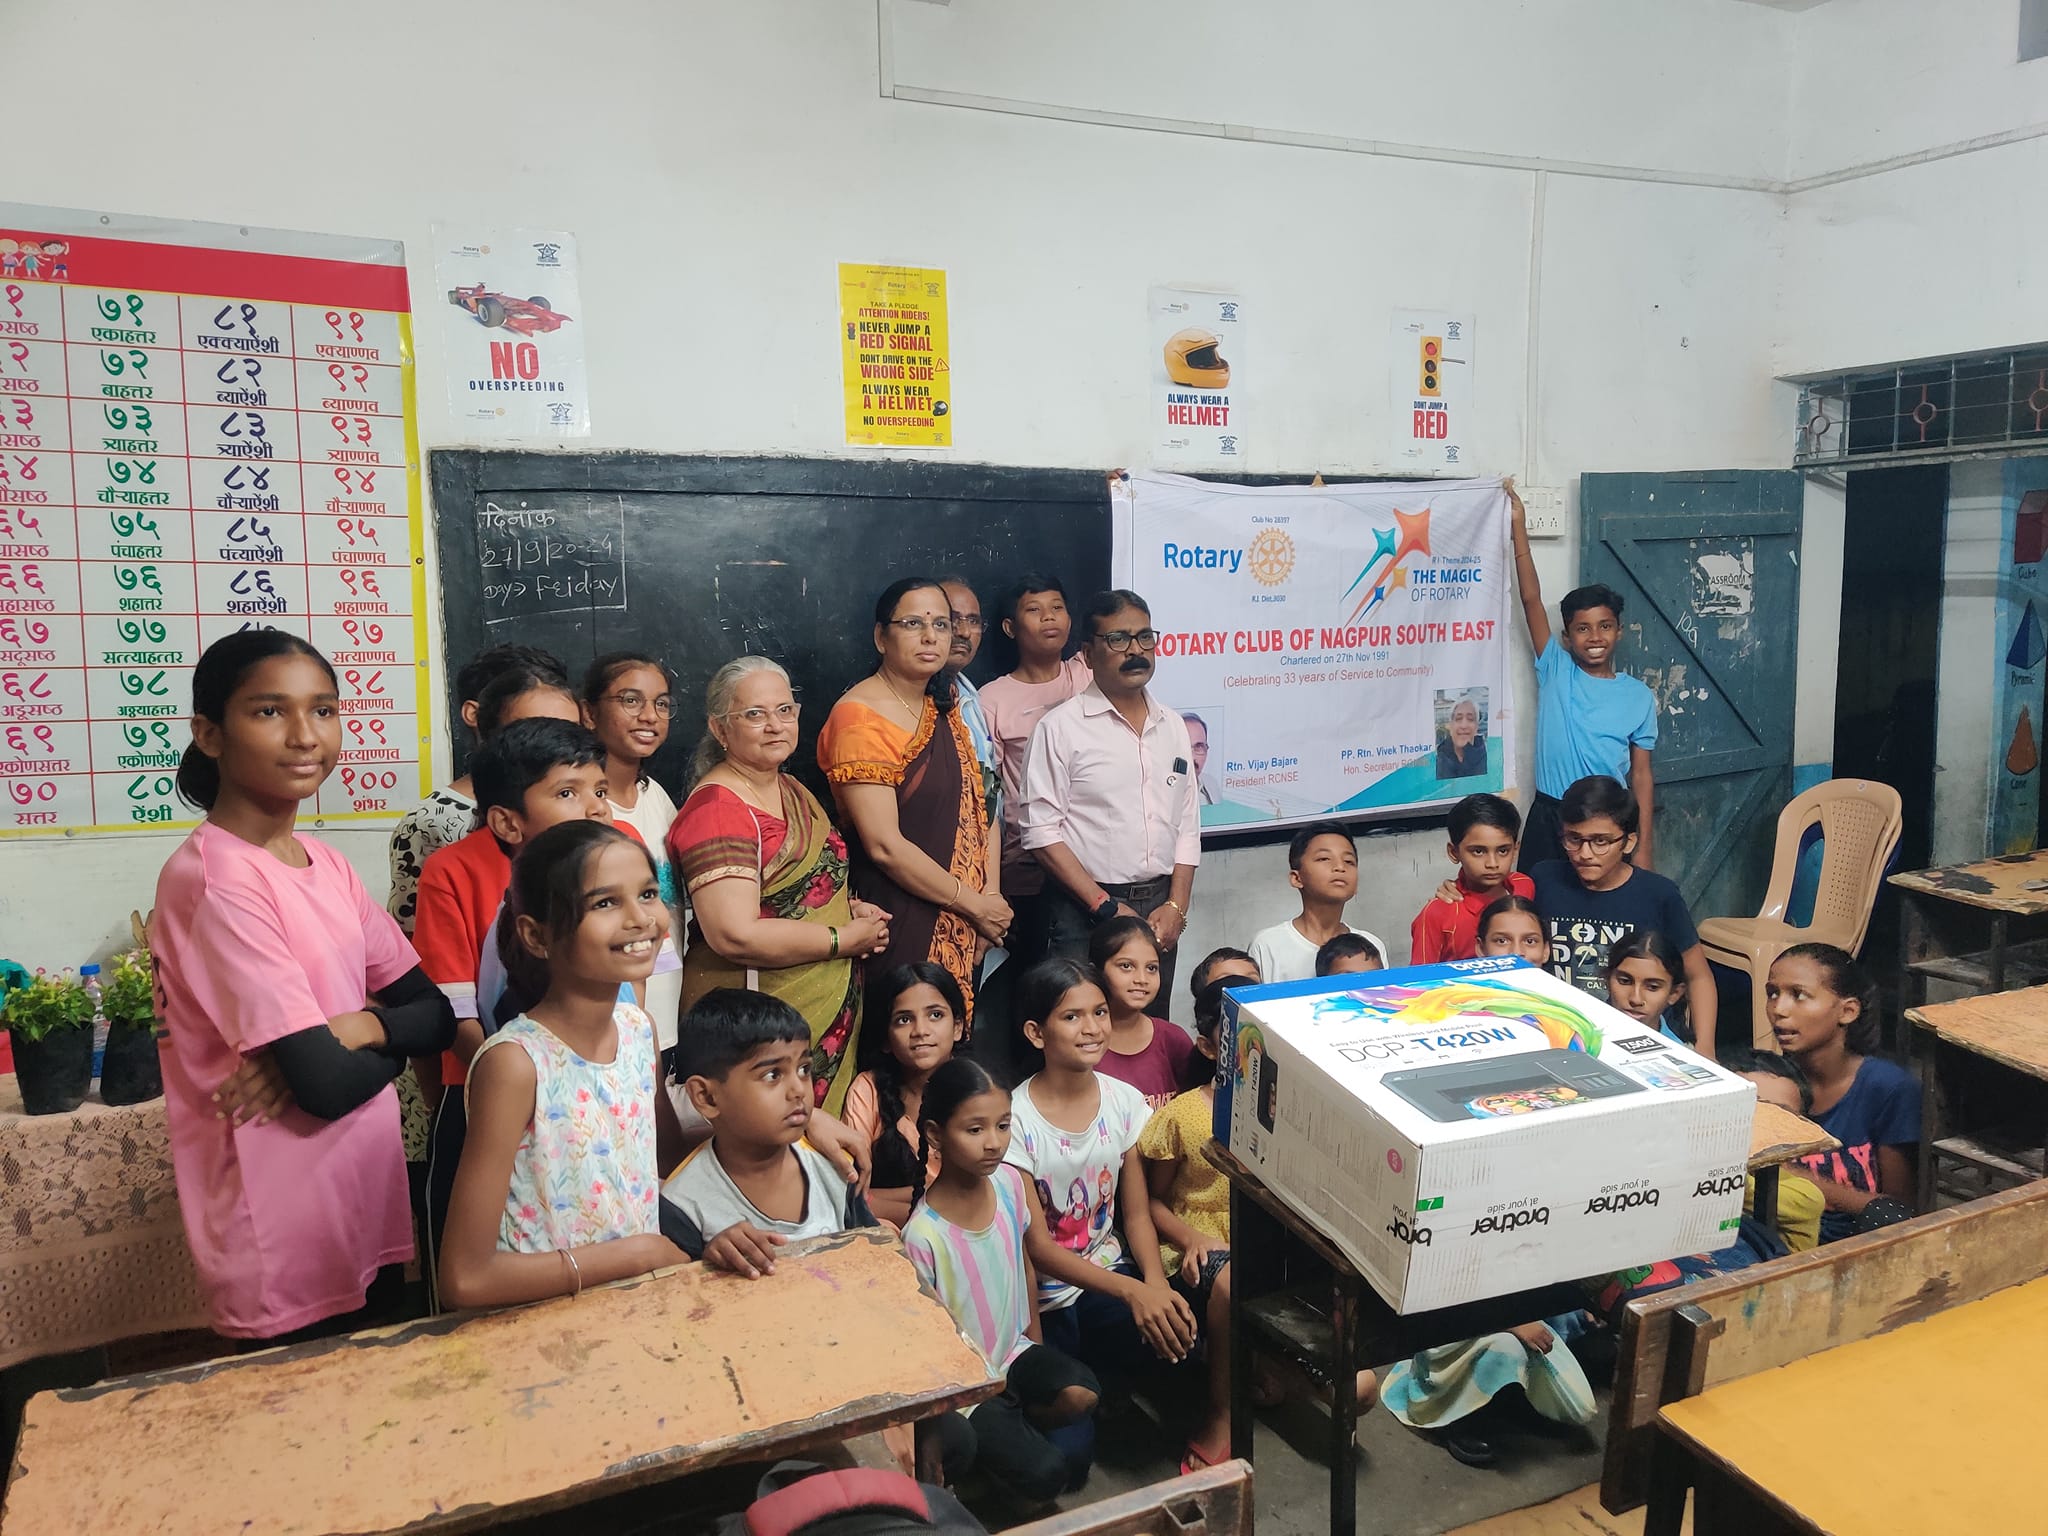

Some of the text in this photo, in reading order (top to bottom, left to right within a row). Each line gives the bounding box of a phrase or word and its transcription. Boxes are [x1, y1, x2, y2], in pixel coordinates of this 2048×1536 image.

[97, 294, 144, 327] ७१
[213, 303, 257, 335] ८१
[859, 308, 931, 321] ATTENTION RIDERS!
[91, 327, 157, 344] एकाहत्तर
[325, 311, 365, 343] ९१
[859, 322, 931, 336] NEVER JUMP A
[859, 333, 934, 352] RED SIGNAL
[101, 349, 149, 380] ७२
[217, 358, 262, 387] ८२
[490, 341, 540, 381] NO
[860, 364, 935, 381] WRONG SIDE
[882, 354, 905, 366] DRIVE
[906, 355, 917, 366] ON
[919, 355, 933, 366] THE
[328, 363, 369, 393] ९२
[469, 380, 565, 392] OVERSPEEDING
[862, 384, 930, 397] ALWAYS WEAR
[101, 383, 153, 399] बाहत्तर
[863, 395, 933, 411] A HELMET
[1167, 393, 1230, 406] ALWAYS WEAR A
[321, 397, 380, 413] ब्याण्णव
[1167, 405, 1230, 427] HELMET
[1428, 402, 1443, 410] JUMP
[1443, 402, 1448, 411] A
[104, 403, 153, 436] ७३
[220, 411, 266, 443] ८३
[331, 416, 372, 447] ९३
[863, 415, 935, 428] NO OVERSPEEDING
[1413, 410, 1448, 440] RED
[107, 457, 157, 485] ७४
[224, 464, 270, 491] ८४
[334, 467, 376, 495] ९४
[110, 511, 160, 540] ७५
[478, 501, 557, 529] दिनांक
[227, 516, 274, 545] ८५
[337, 518, 379, 546] ९५
[111, 540, 163, 559] पंचाहत्तर
[1163, 543, 1243, 574] Rotary
[114, 564, 162, 595] ७६
[230, 569, 276, 599] ८६
[340, 568, 381, 598] ९६
[1413, 568, 1482, 584] THE MAGIC
[119, 597, 163, 611] शहात्तर
[226, 596, 287, 614] शहाऐंशी
[1411, 587, 1471, 602] OF ROTARY
[334, 601, 389, 615] शहाण्णव
[0, 618, 49, 648] ६७
[117, 618, 167, 643] ७७
[342, 619, 384, 647] ९७
[1234, 629, 1284, 654] CLUB
[1289, 628, 1314, 651] OF
[1320, 626, 1392, 649] NAGPUR
[1396, 623, 1447, 645] SOUTH
[1452, 620, 1495, 642] EAST
[1280, 651, 1389, 666] Chartered on 27th Nov 1991
[2, 672, 52, 702] ६८
[120, 670, 169, 696] ७८
[345, 669, 385, 696] ९८
[1223, 663, 1434, 689] (Celebrating 33 years of Service to Community)
[5, 725, 55, 756] ६९
[123, 721, 172, 749] ७९
[347, 719, 387, 745] ९९
[1226, 756, 1298, 772] Rtn. Vijay Bajare
[1357, 748, 1374, 758] Rtn.
[1376, 745, 1397, 756] Vivek
[1363, 760, 1399, 773] Secretary
[127, 774, 173, 800] ८०
[341, 767, 397, 797] १००
[1225, 771, 1299, 788] President RCNSE
[8, 780, 57, 805] ७०
[353, 795, 387, 813] शंभर
[14, 811, 57, 825] सत्तर
[131, 804, 173, 822] ऐंशी
[1445, 957, 1518, 971] brother
[1708, 1167, 1725, 1178] side
[1600, 1179, 1650, 1194] at your side
[1692, 1174, 1745, 1198] other
[1426, 1199, 1435, 1210] 7
[1487, 1197, 1539, 1214] at your side
[1584, 1188, 1660, 1215] brother
[1470, 1206, 1550, 1236] brother
